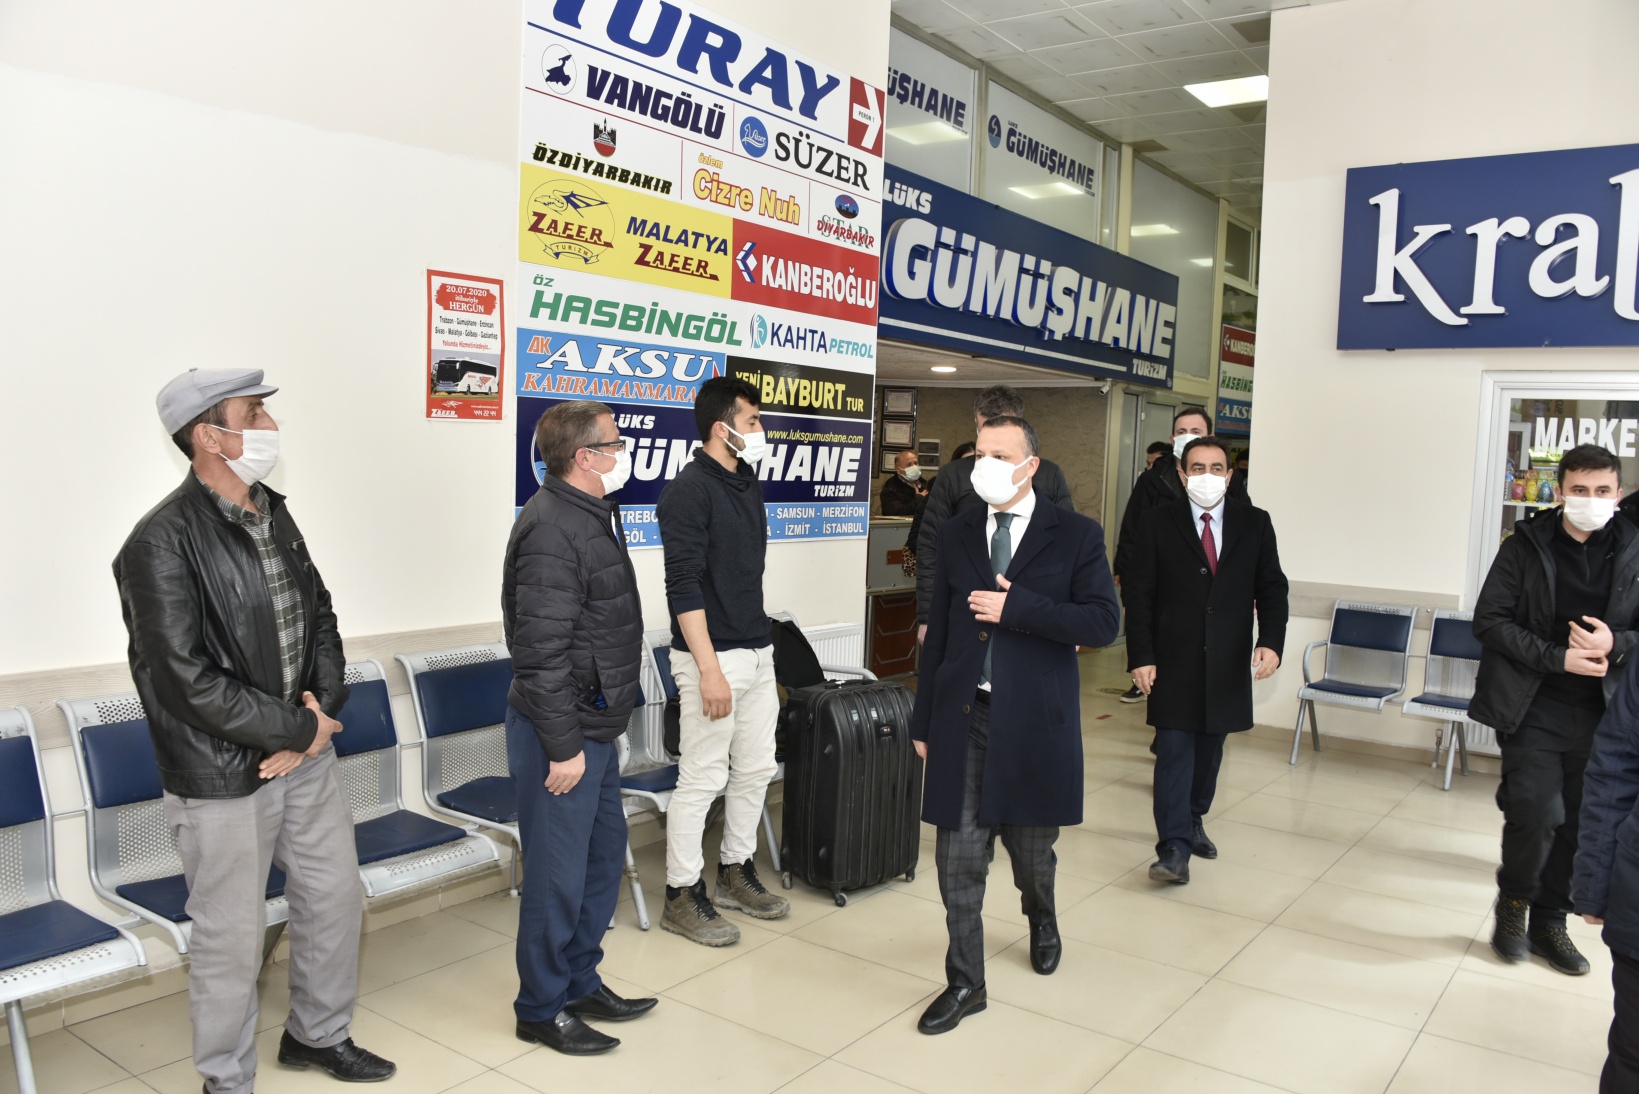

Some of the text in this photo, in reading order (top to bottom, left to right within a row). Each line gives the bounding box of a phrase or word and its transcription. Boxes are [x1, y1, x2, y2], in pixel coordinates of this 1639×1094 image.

[586, 64, 726, 140] VANGÖLÜ
[858, 110, 872, 122] PERON
[532, 142, 672, 195] ÖZDİYARBAKIR
[698, 152, 723, 169] özlem
[775, 131, 869, 191] SÜZER
[1006, 127, 1095, 190] GÜMÜŞHANE
[693, 168, 800, 226] Cizre Nuh
[883, 178, 933, 215] LÜKS
[528, 211, 612, 247] ZAFER
[626, 216, 729, 256] MALATYA
[1363, 168, 1639, 326] kral
[634, 242, 717, 279] ZAFER
[446, 285, 487, 297] 20.07.2020
[533, 273, 555, 288] ÖZ
[761, 253, 876, 309] KANBEROĞLU
[885, 217, 1177, 359] GÜMÜŞHANE
[530, 289, 743, 347] HASBİNGÖL
[527, 335, 552, 356] AK
[770, 322, 874, 359] KAHTA PETROL
[536, 339, 713, 382] AKSU
[761, 374, 846, 410] BAYBURT
[846, 397, 864, 412] TUR
[767, 428, 864, 444] www.luksgumushane.com
[1534, 417, 1638, 458] MARKE
[777, 506, 815, 519] SAMSUN
[822, 504, 865, 518] MERZİFON
[785, 521, 811, 536] İZMİT
[823, 520, 864, 534] İSTANBUL
